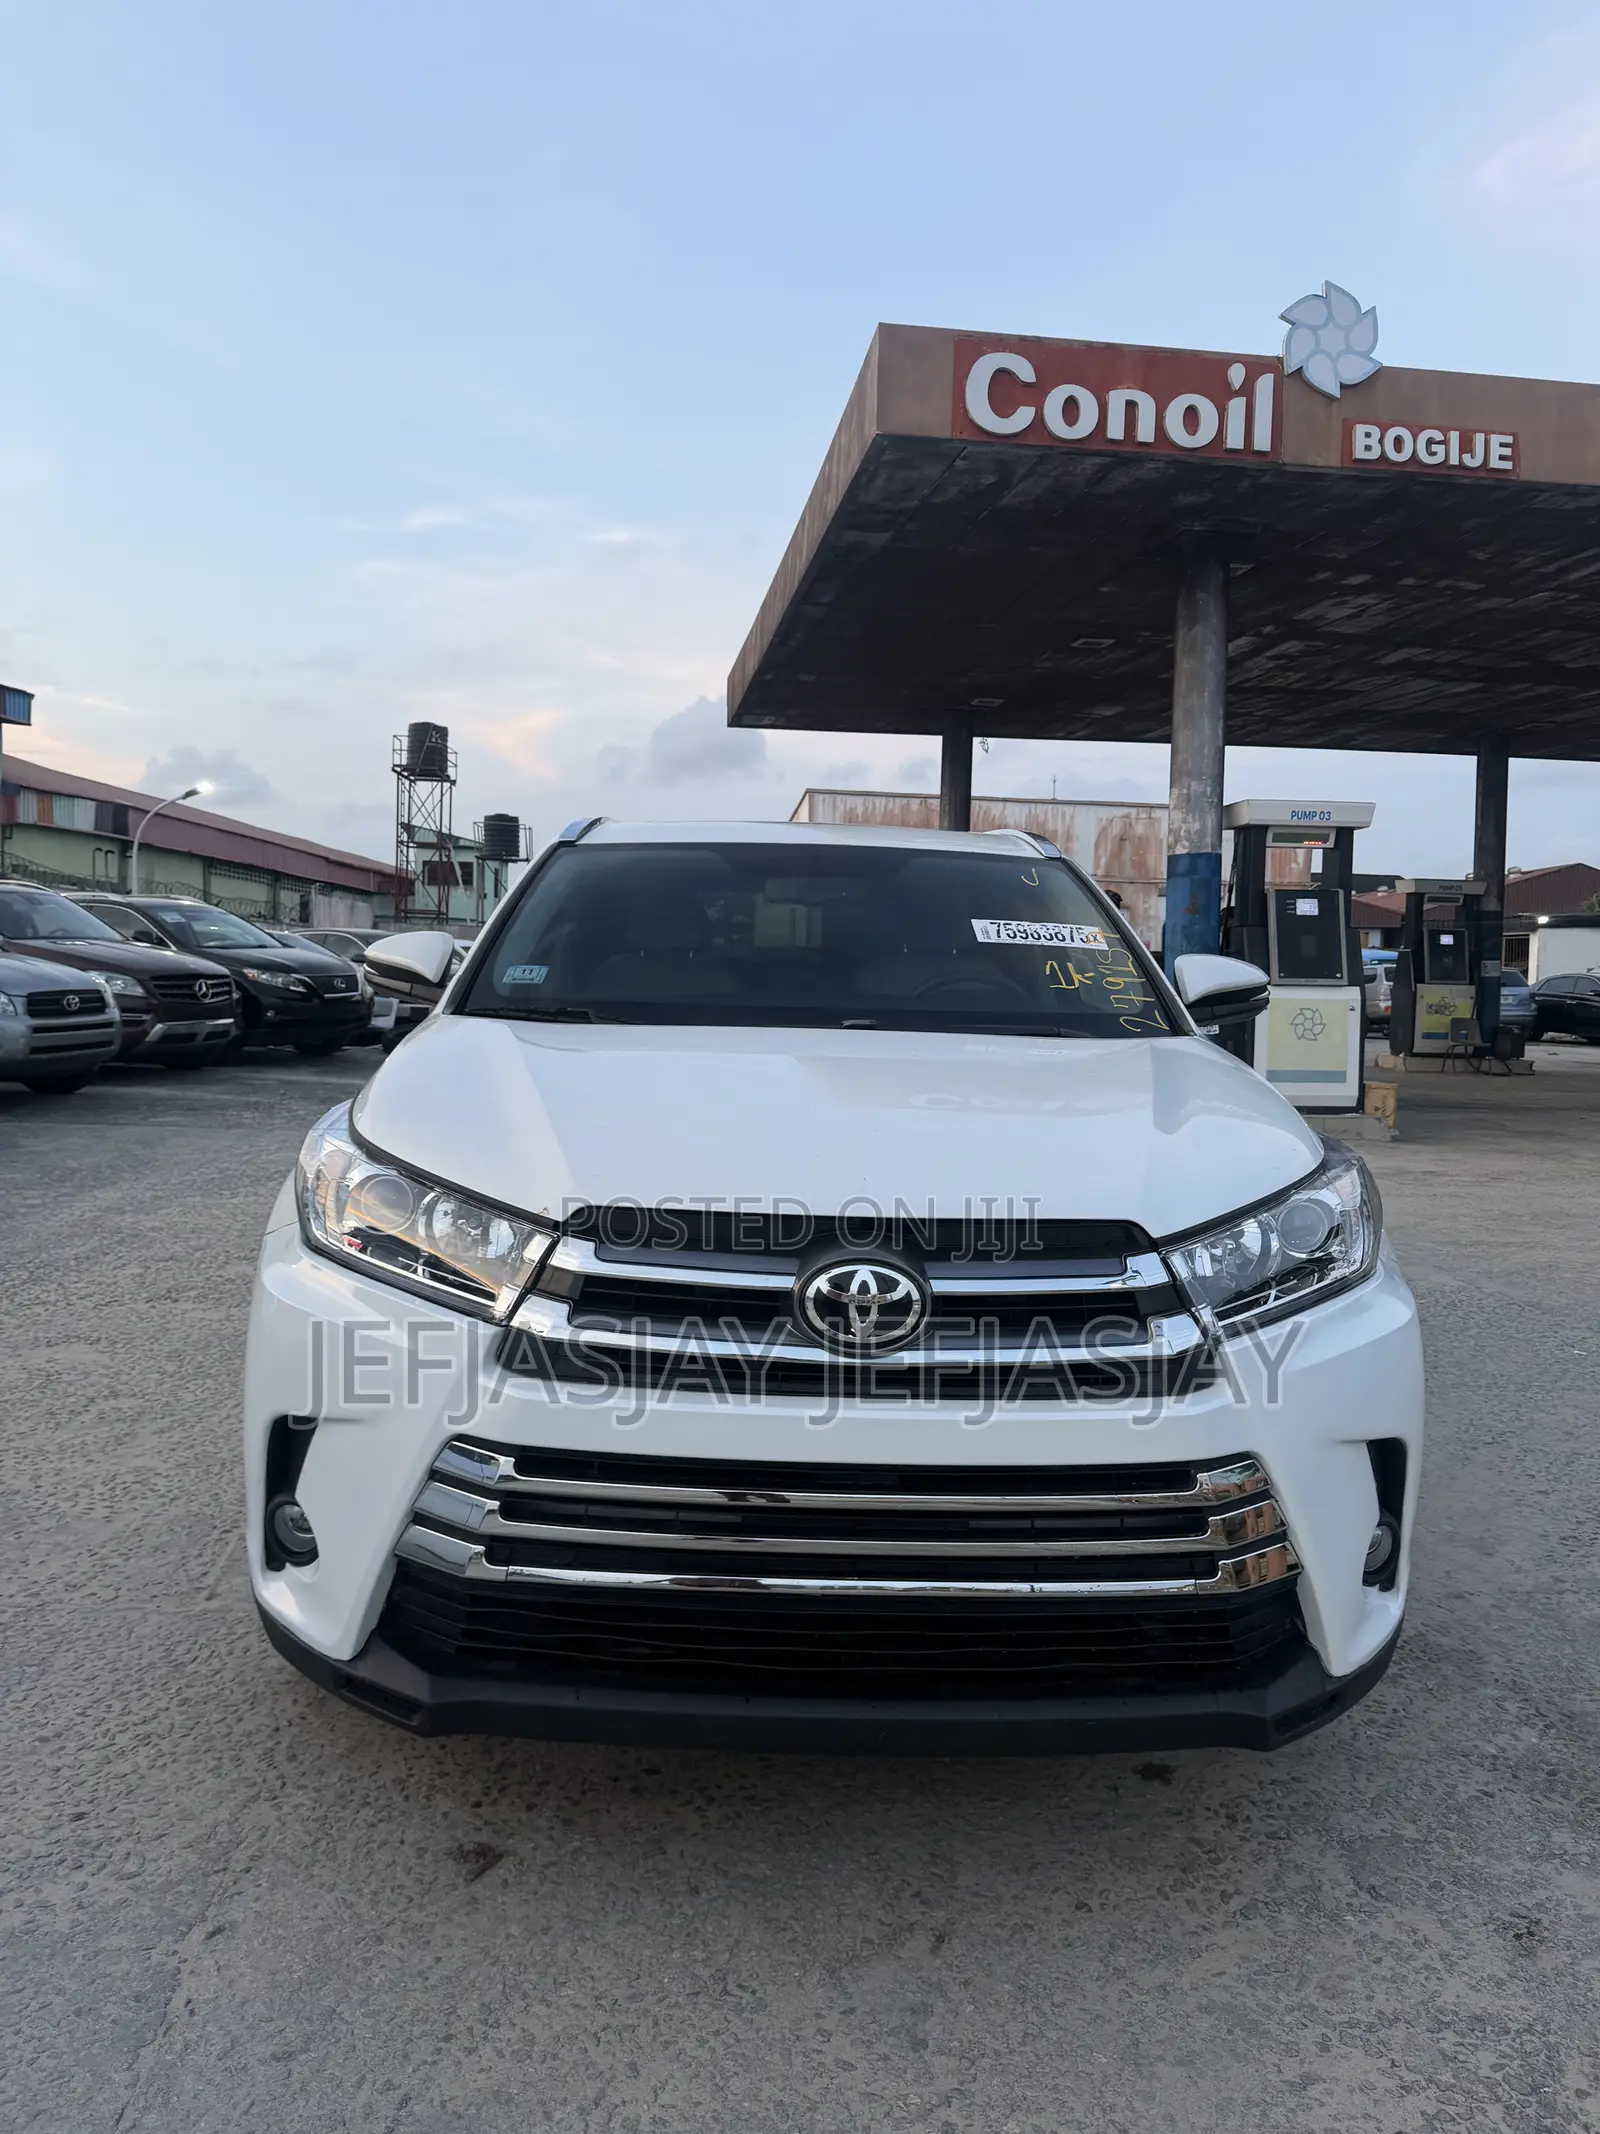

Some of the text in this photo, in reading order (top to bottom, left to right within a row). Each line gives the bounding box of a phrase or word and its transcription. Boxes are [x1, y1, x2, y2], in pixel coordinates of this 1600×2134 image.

[965, 352, 1274, 452] Conoil
[1352, 424, 1513, 470] BOGIJE
[1290, 810, 1331, 821] PUMP 03
